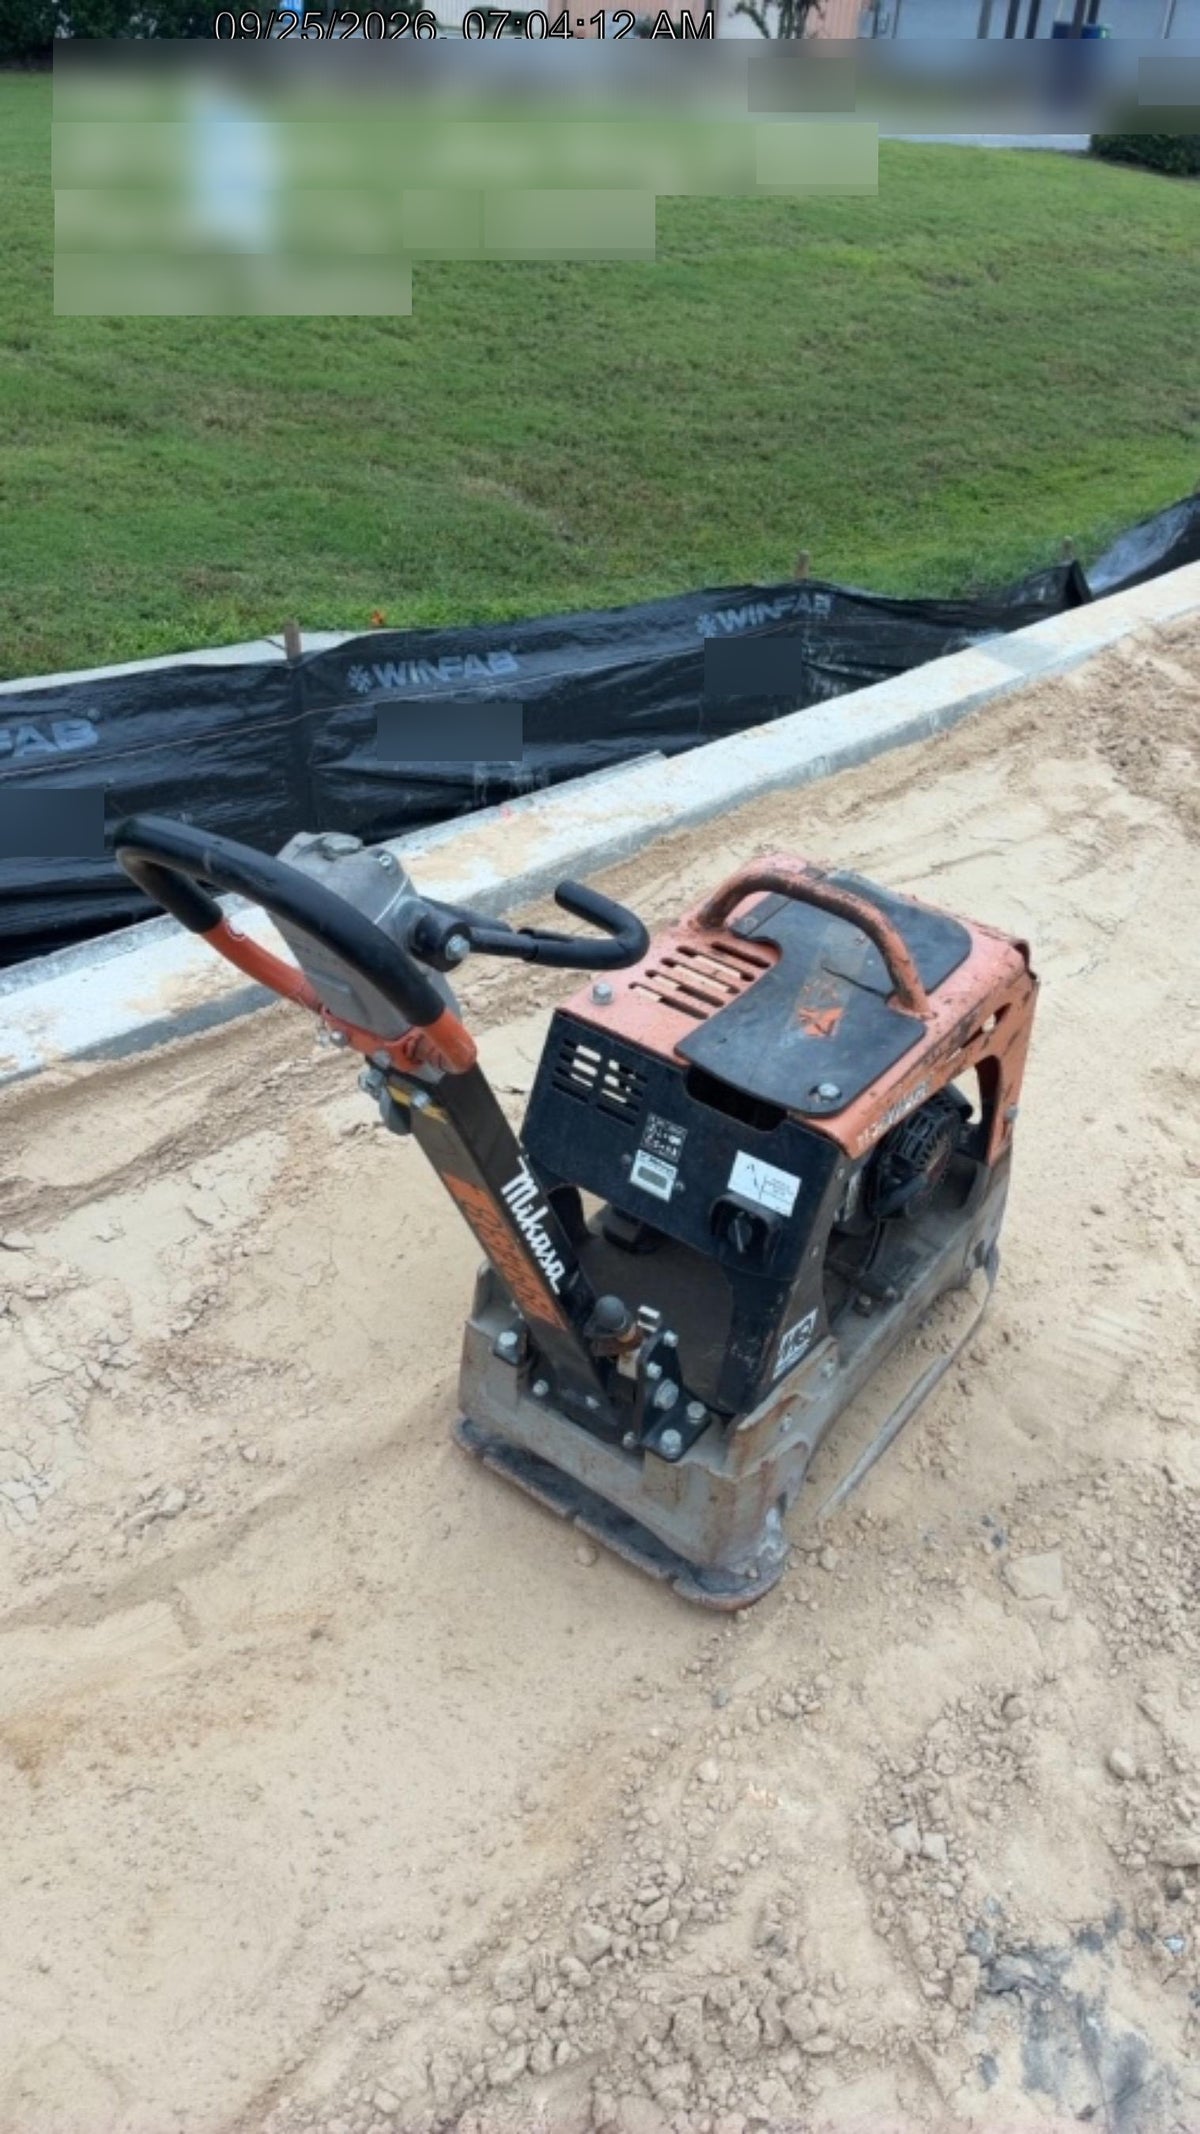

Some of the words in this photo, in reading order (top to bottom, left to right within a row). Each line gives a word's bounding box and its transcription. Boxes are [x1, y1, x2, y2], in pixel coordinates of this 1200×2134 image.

[715, 592, 832, 633] WINFAB
[371, 649, 520, 689] WINFAB
[500, 1155, 566, 1295] Mikasa
